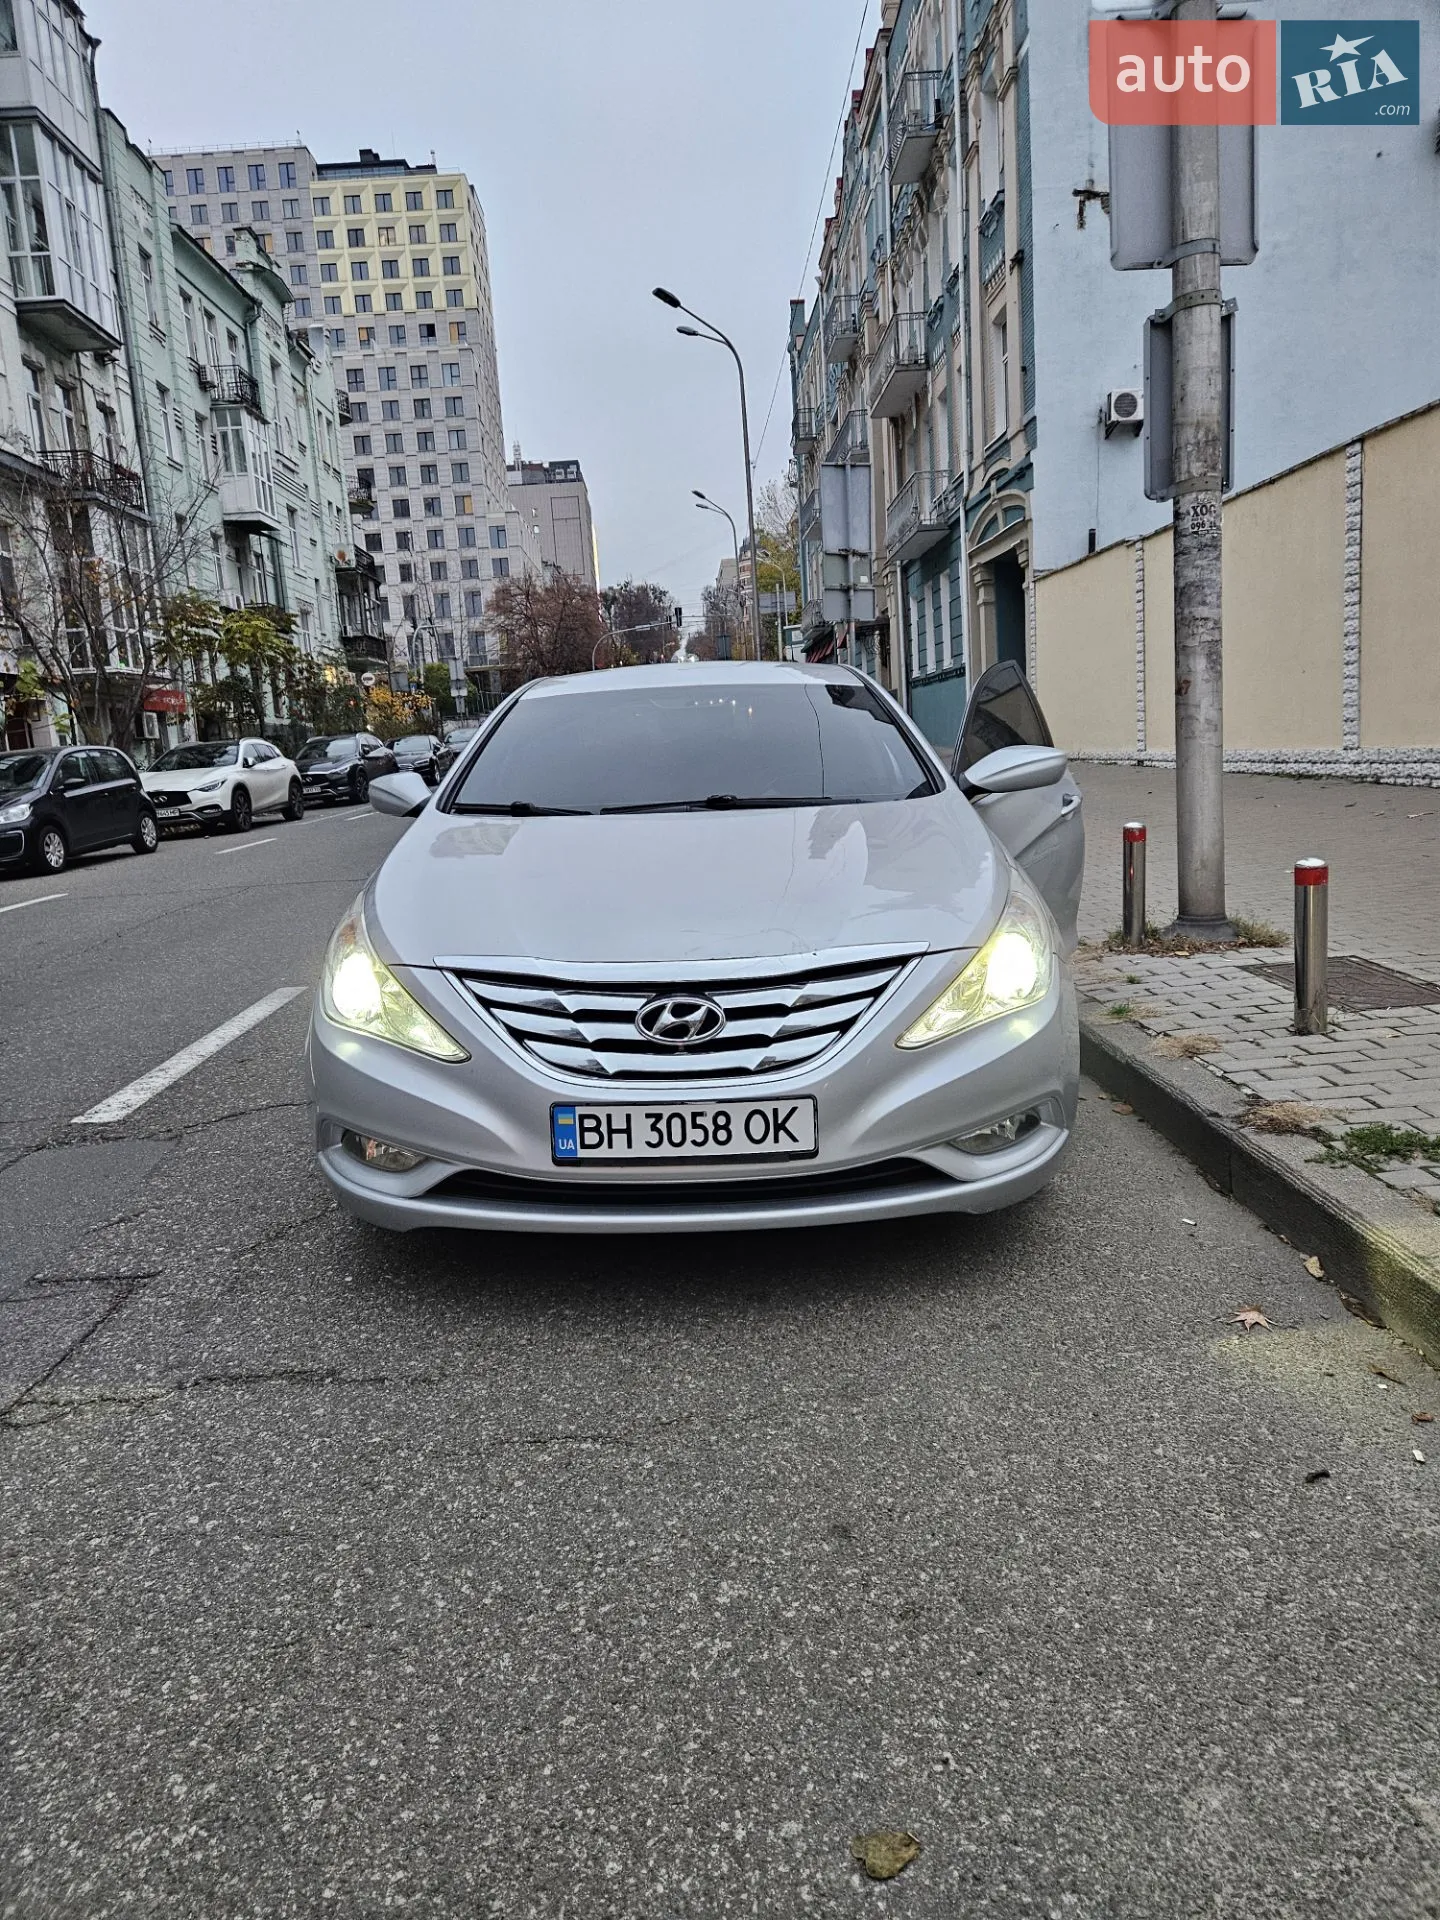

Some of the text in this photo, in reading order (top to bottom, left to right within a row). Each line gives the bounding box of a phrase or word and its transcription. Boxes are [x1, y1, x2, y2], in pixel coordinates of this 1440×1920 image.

[578, 1106, 799, 1150] BH 3058 OK
[558, 1138, 575, 1150] UA
